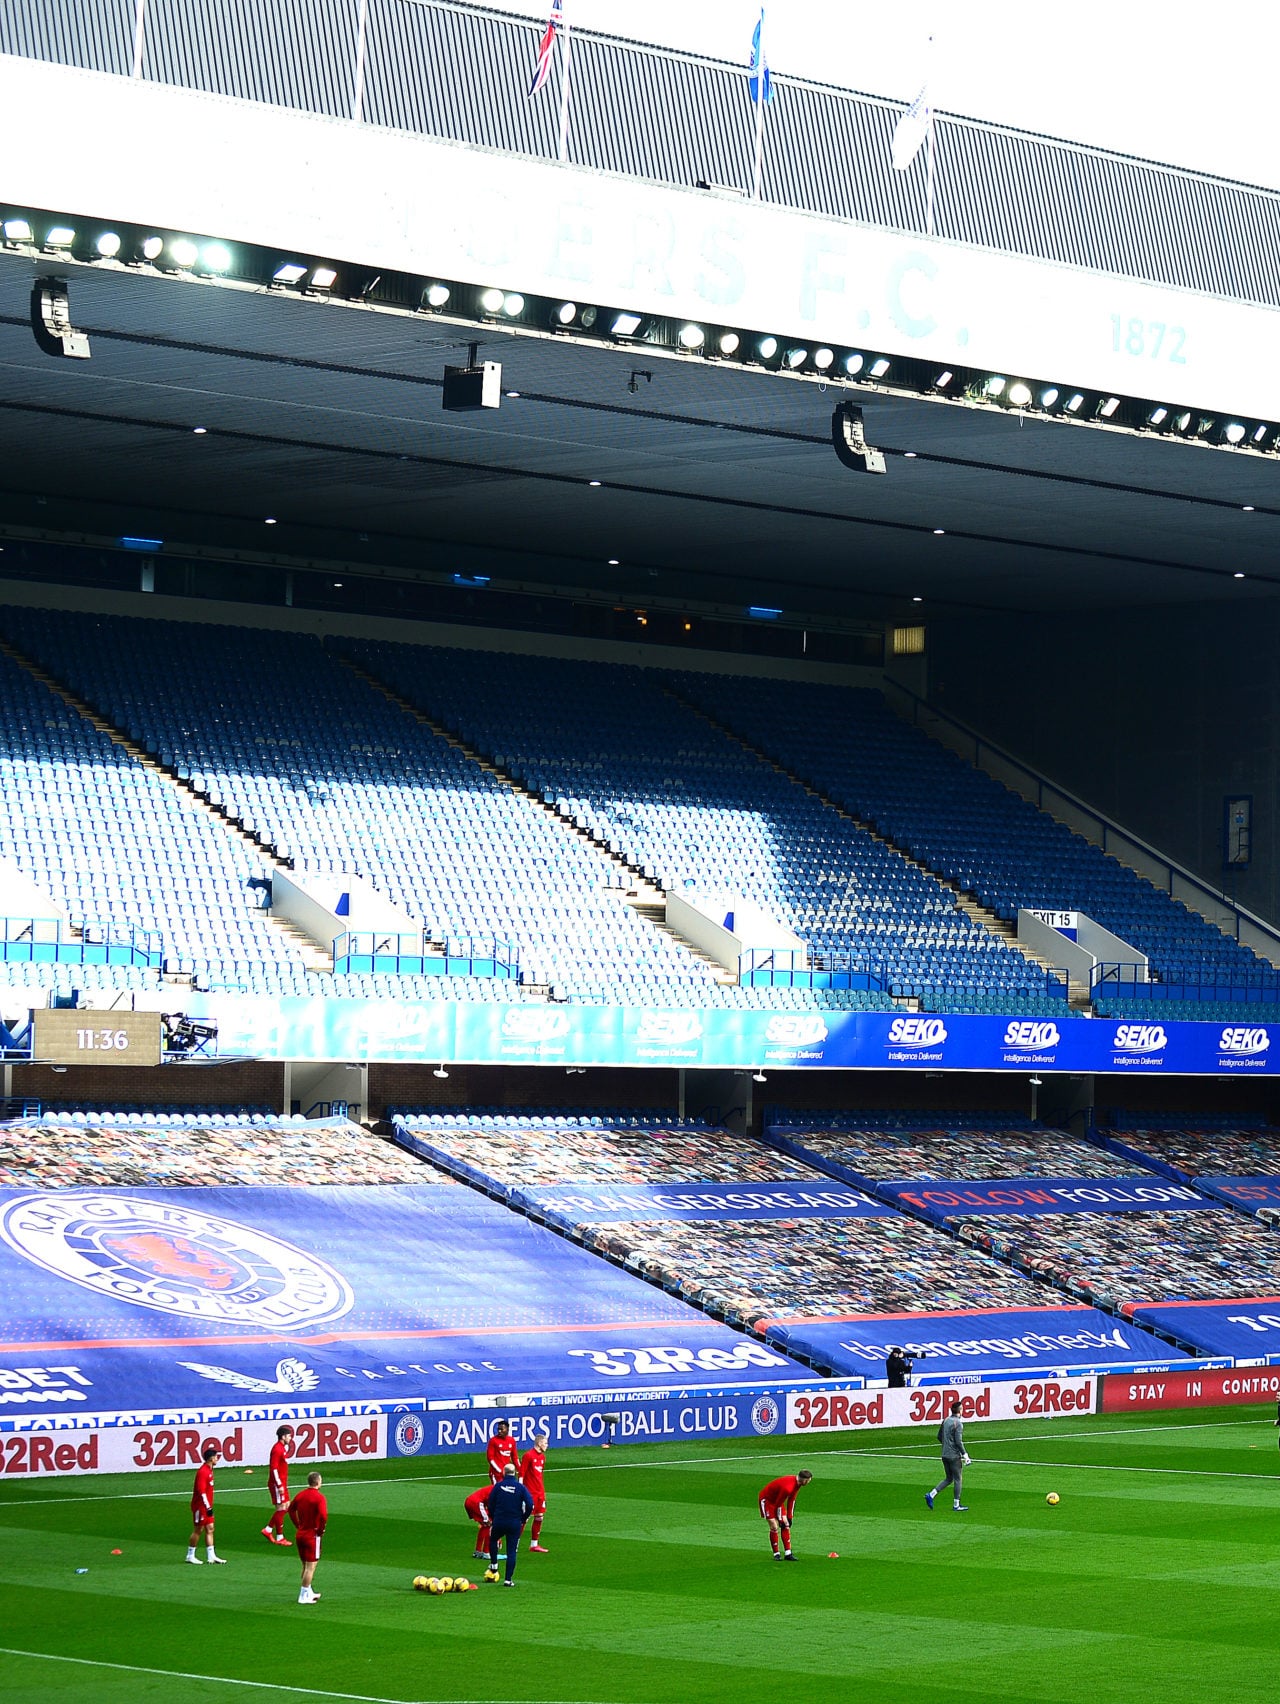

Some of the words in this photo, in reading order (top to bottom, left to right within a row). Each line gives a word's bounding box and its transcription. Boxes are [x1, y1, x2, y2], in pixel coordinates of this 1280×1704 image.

[1110, 312, 1187, 365] 1872
[1059, 913, 1071, 926] 15
[76, 1029, 129, 1050] 11:36
[764, 1015, 828, 1043] SEKO
[888, 1018, 947, 1044] SEKO
[1003, 1021, 1060, 1047] SEKO
[1113, 1025, 1167, 1051] SEKO
[1219, 1028, 1270, 1053] SEKO
[888, 1052, 918, 1061] Intelligence
[918, 1052, 943, 1061] Delivered
[1003, 1053, 1032, 1063] Intelligence
[1032, 1054, 1056, 1063] Delivered
[1113, 1057, 1140, 1066] Intelligence
[1140, 1057, 1164, 1066] Delivered
[536, 1191, 882, 1214] #RANGERSREADY
[898, 1189, 1058, 1209] FOLLOW
[1052, 1185, 1203, 1203] FOLLOW
[568, 1341, 790, 1375] 32Red
[335, 1361, 503, 1380] CASTORE
[949, 1375, 981, 1384] SCOTTISH
[542, 1396, 563, 1405] BEEN
[564, 1394, 603, 1404] INVOLVED
[604, 1393, 613, 1402] IN
[614, 1393, 626, 1402] AN
[627, 1391, 670, 1400] ACCIDENT?
[1129, 1383, 1166, 1401] STAY
[1186, 1381, 1202, 1397] IN
[793, 1394, 884, 1428] 32Red
[910, 1387, 990, 1422] 32Red
[1013, 1381, 1091, 1415] 32Red
[679, 1405, 738, 1431] CLUB
[0, 1434, 98, 1473] 2Red
[133, 1427, 243, 1467] 32Red
